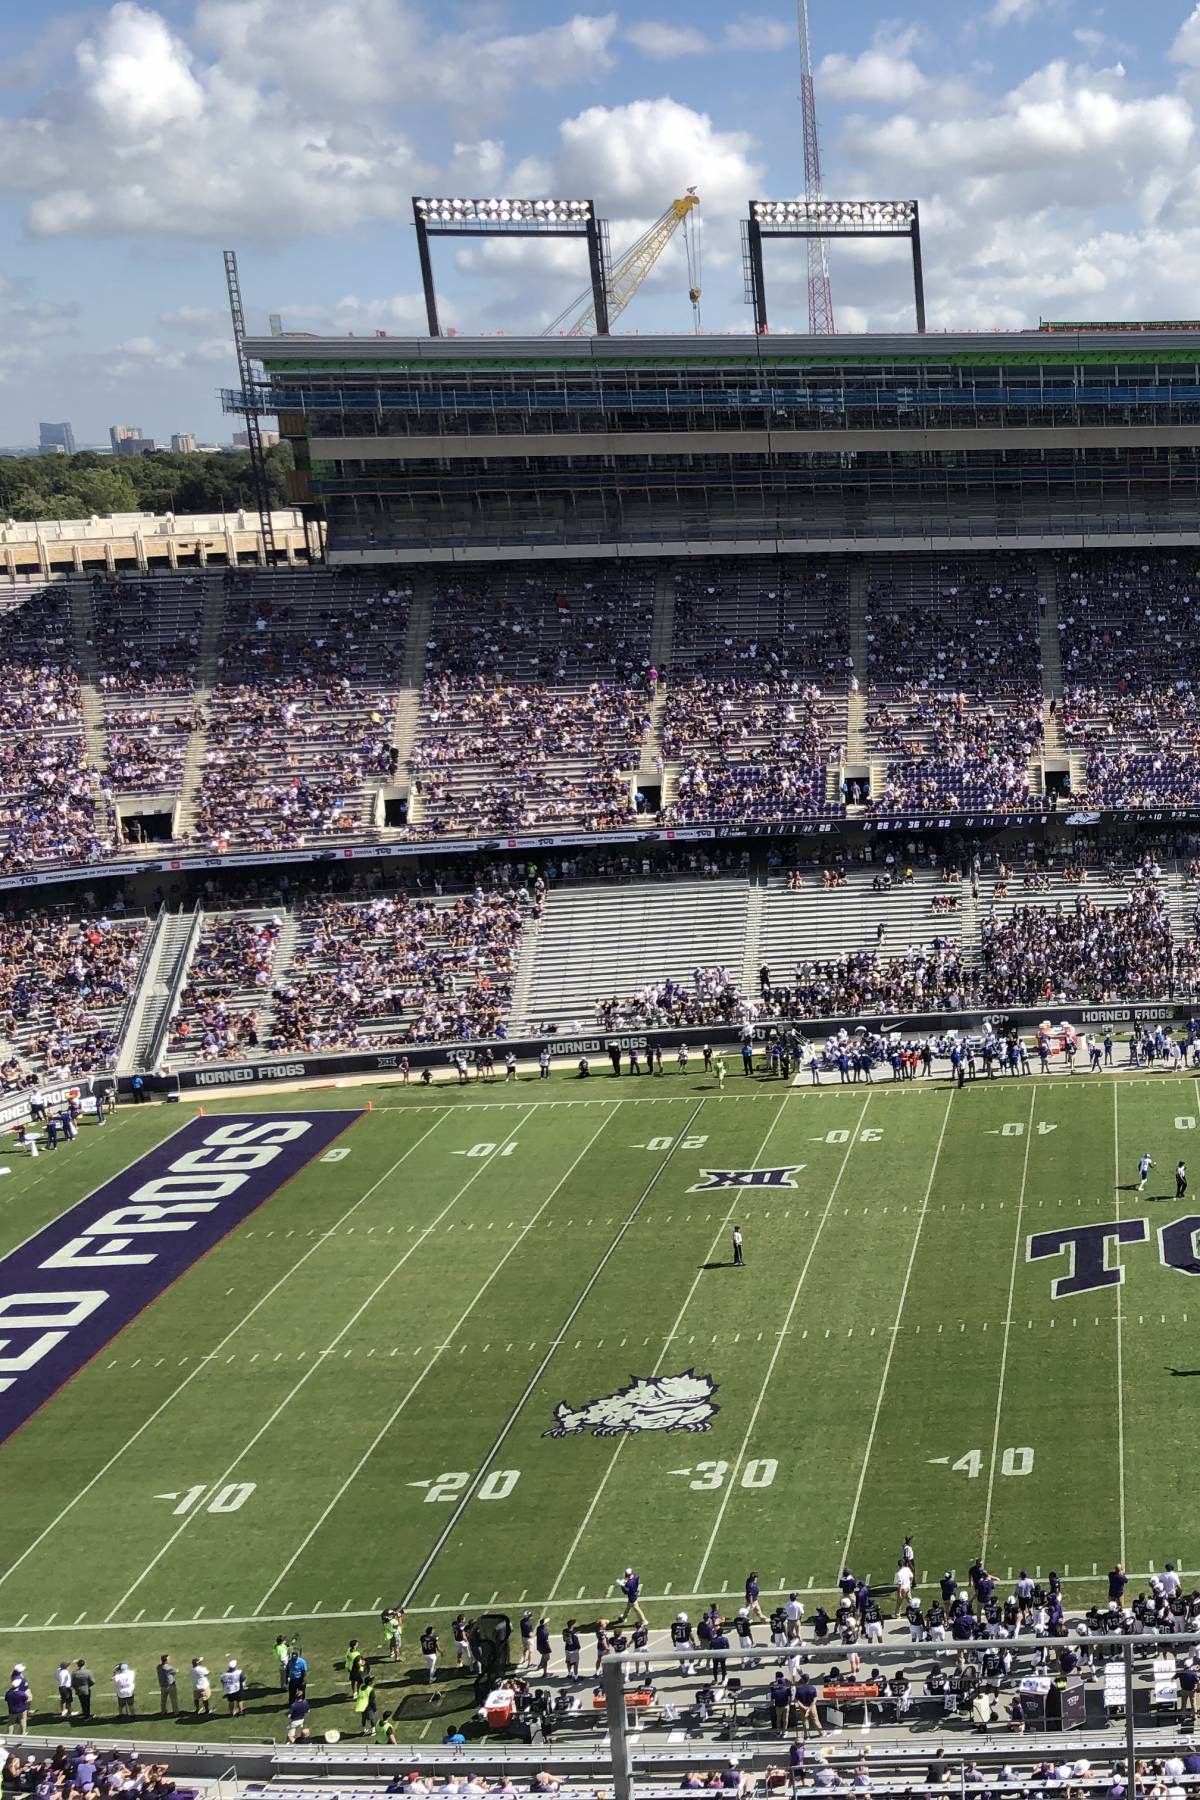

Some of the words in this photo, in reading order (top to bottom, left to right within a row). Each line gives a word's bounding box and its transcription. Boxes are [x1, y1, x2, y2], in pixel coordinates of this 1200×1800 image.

[1082, 1011, 1130, 1022] HORNED
[1134, 1009, 1173, 1020] FROGS
[547, 1041, 600, 1055] HORNED
[604, 1037, 648, 1051] FROGS
[195, 1069, 253, 1084] HORNED
[258, 1064, 305, 1078] FROGS
[824, 1128, 884, 1143] 30
[1003, 1121, 1058, 1136] 40
[467, 1142, 518, 1157] 10
[646, 1135, 709, 1151] 20
[38, 1120, 312, 1268] FROGS
[953, 1446, 1035, 1478] 40
[688, 1459, 778, 1491] 30
[423, 1470, 520, 1503] 20
[173, 1482, 257, 1515] 10
[865, 1611, 877, 1620] 42
[771, 1621, 782, 1629] 24
[675, 1628, 686, 1638] 31
[892, 1685, 904, 1694] 32
[1066, 1696, 1079, 1704] TCU
